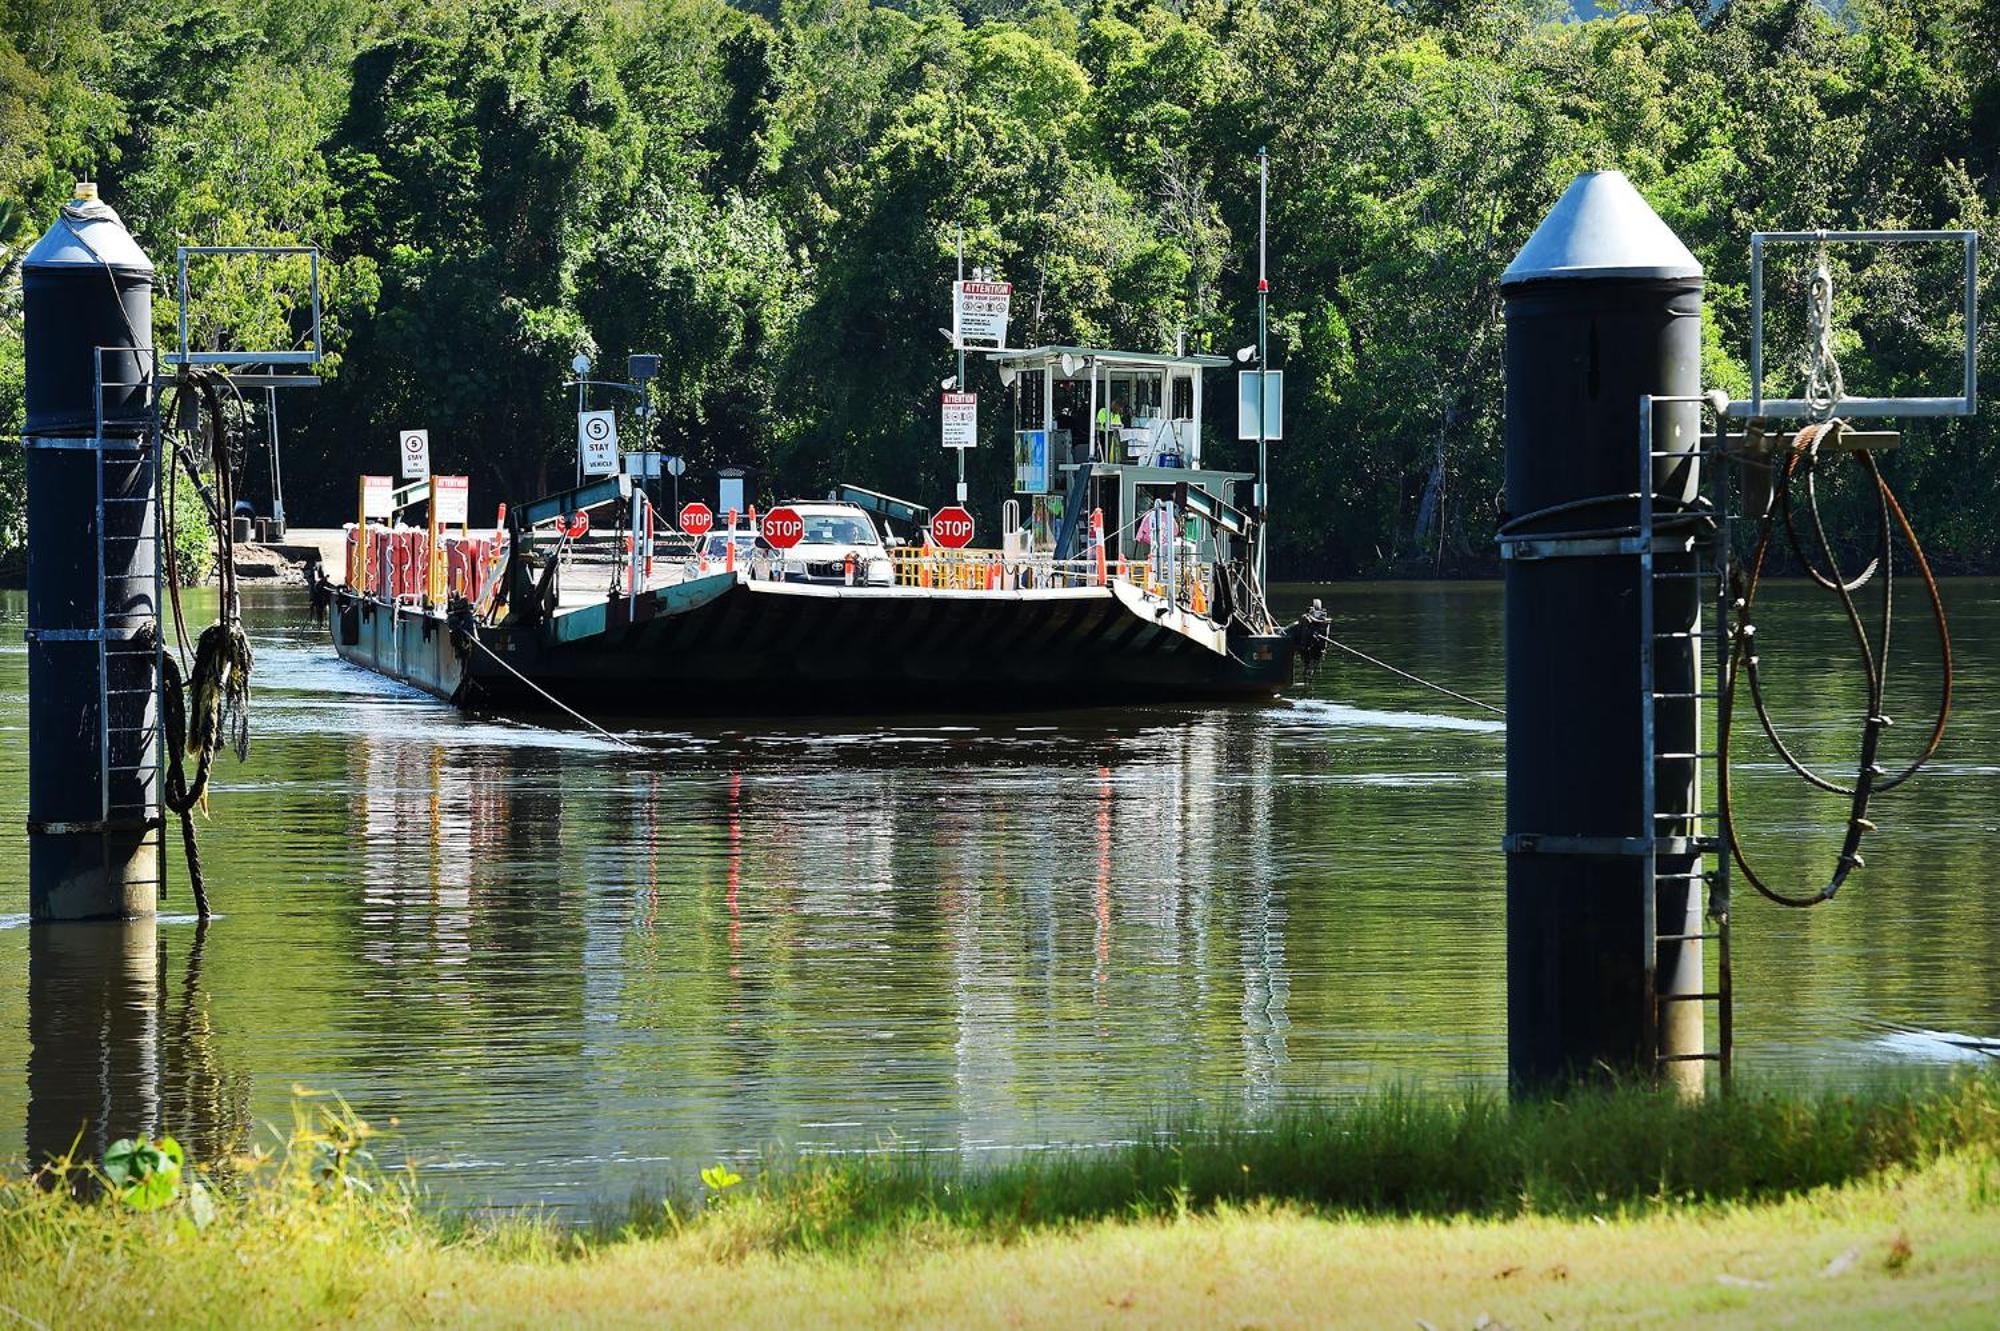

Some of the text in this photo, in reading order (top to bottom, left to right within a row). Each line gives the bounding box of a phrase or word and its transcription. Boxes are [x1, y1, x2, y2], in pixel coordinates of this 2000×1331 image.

[964, 283, 1009, 294] ATTENTION
[594, 424, 602, 434] 5
[411, 439, 417, 448] 5
[589, 443, 609, 452] STAY
[558, 516, 587, 529] SOP
[682, 513, 710, 526] STOP
[765, 521, 802, 536] STOP
[935, 520, 972, 536] STOP
